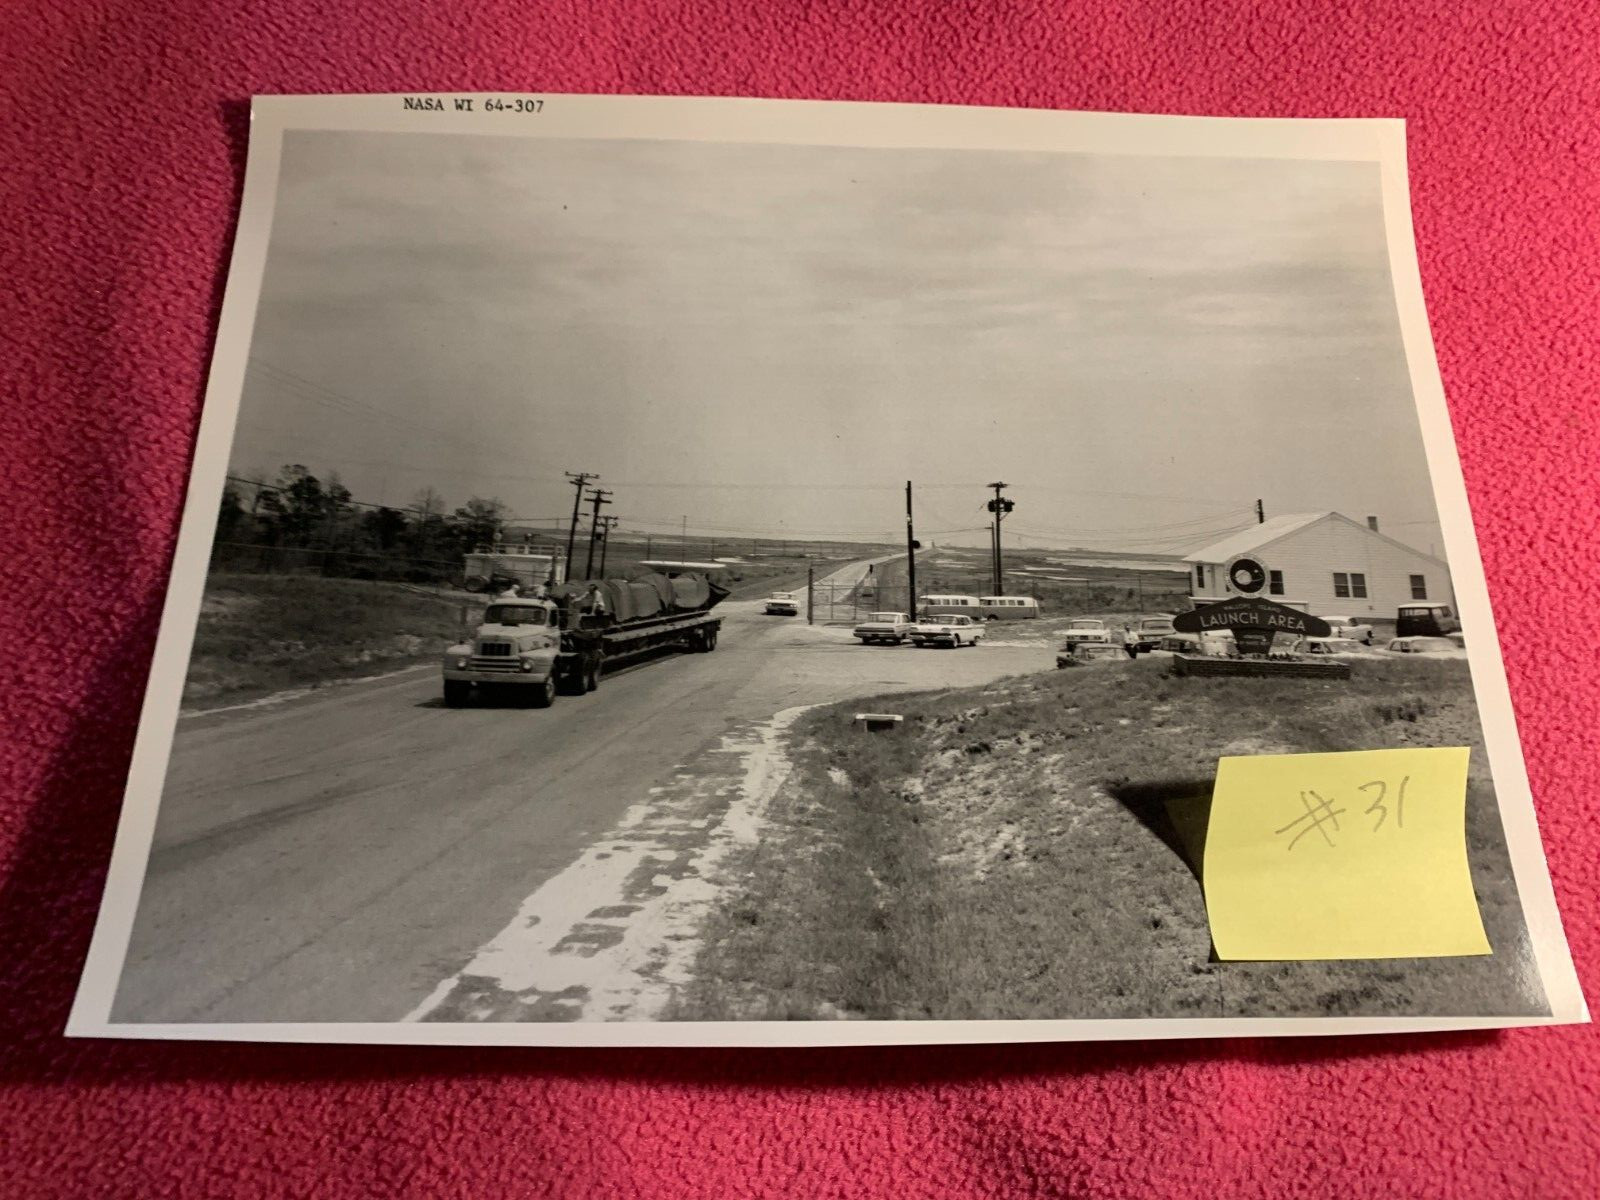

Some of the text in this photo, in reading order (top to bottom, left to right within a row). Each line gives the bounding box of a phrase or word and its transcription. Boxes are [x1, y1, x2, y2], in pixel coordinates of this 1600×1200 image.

[403, 97, 544, 113] NASA WI 64-307
[1200, 612, 1306, 631] LAUNCH AREA
